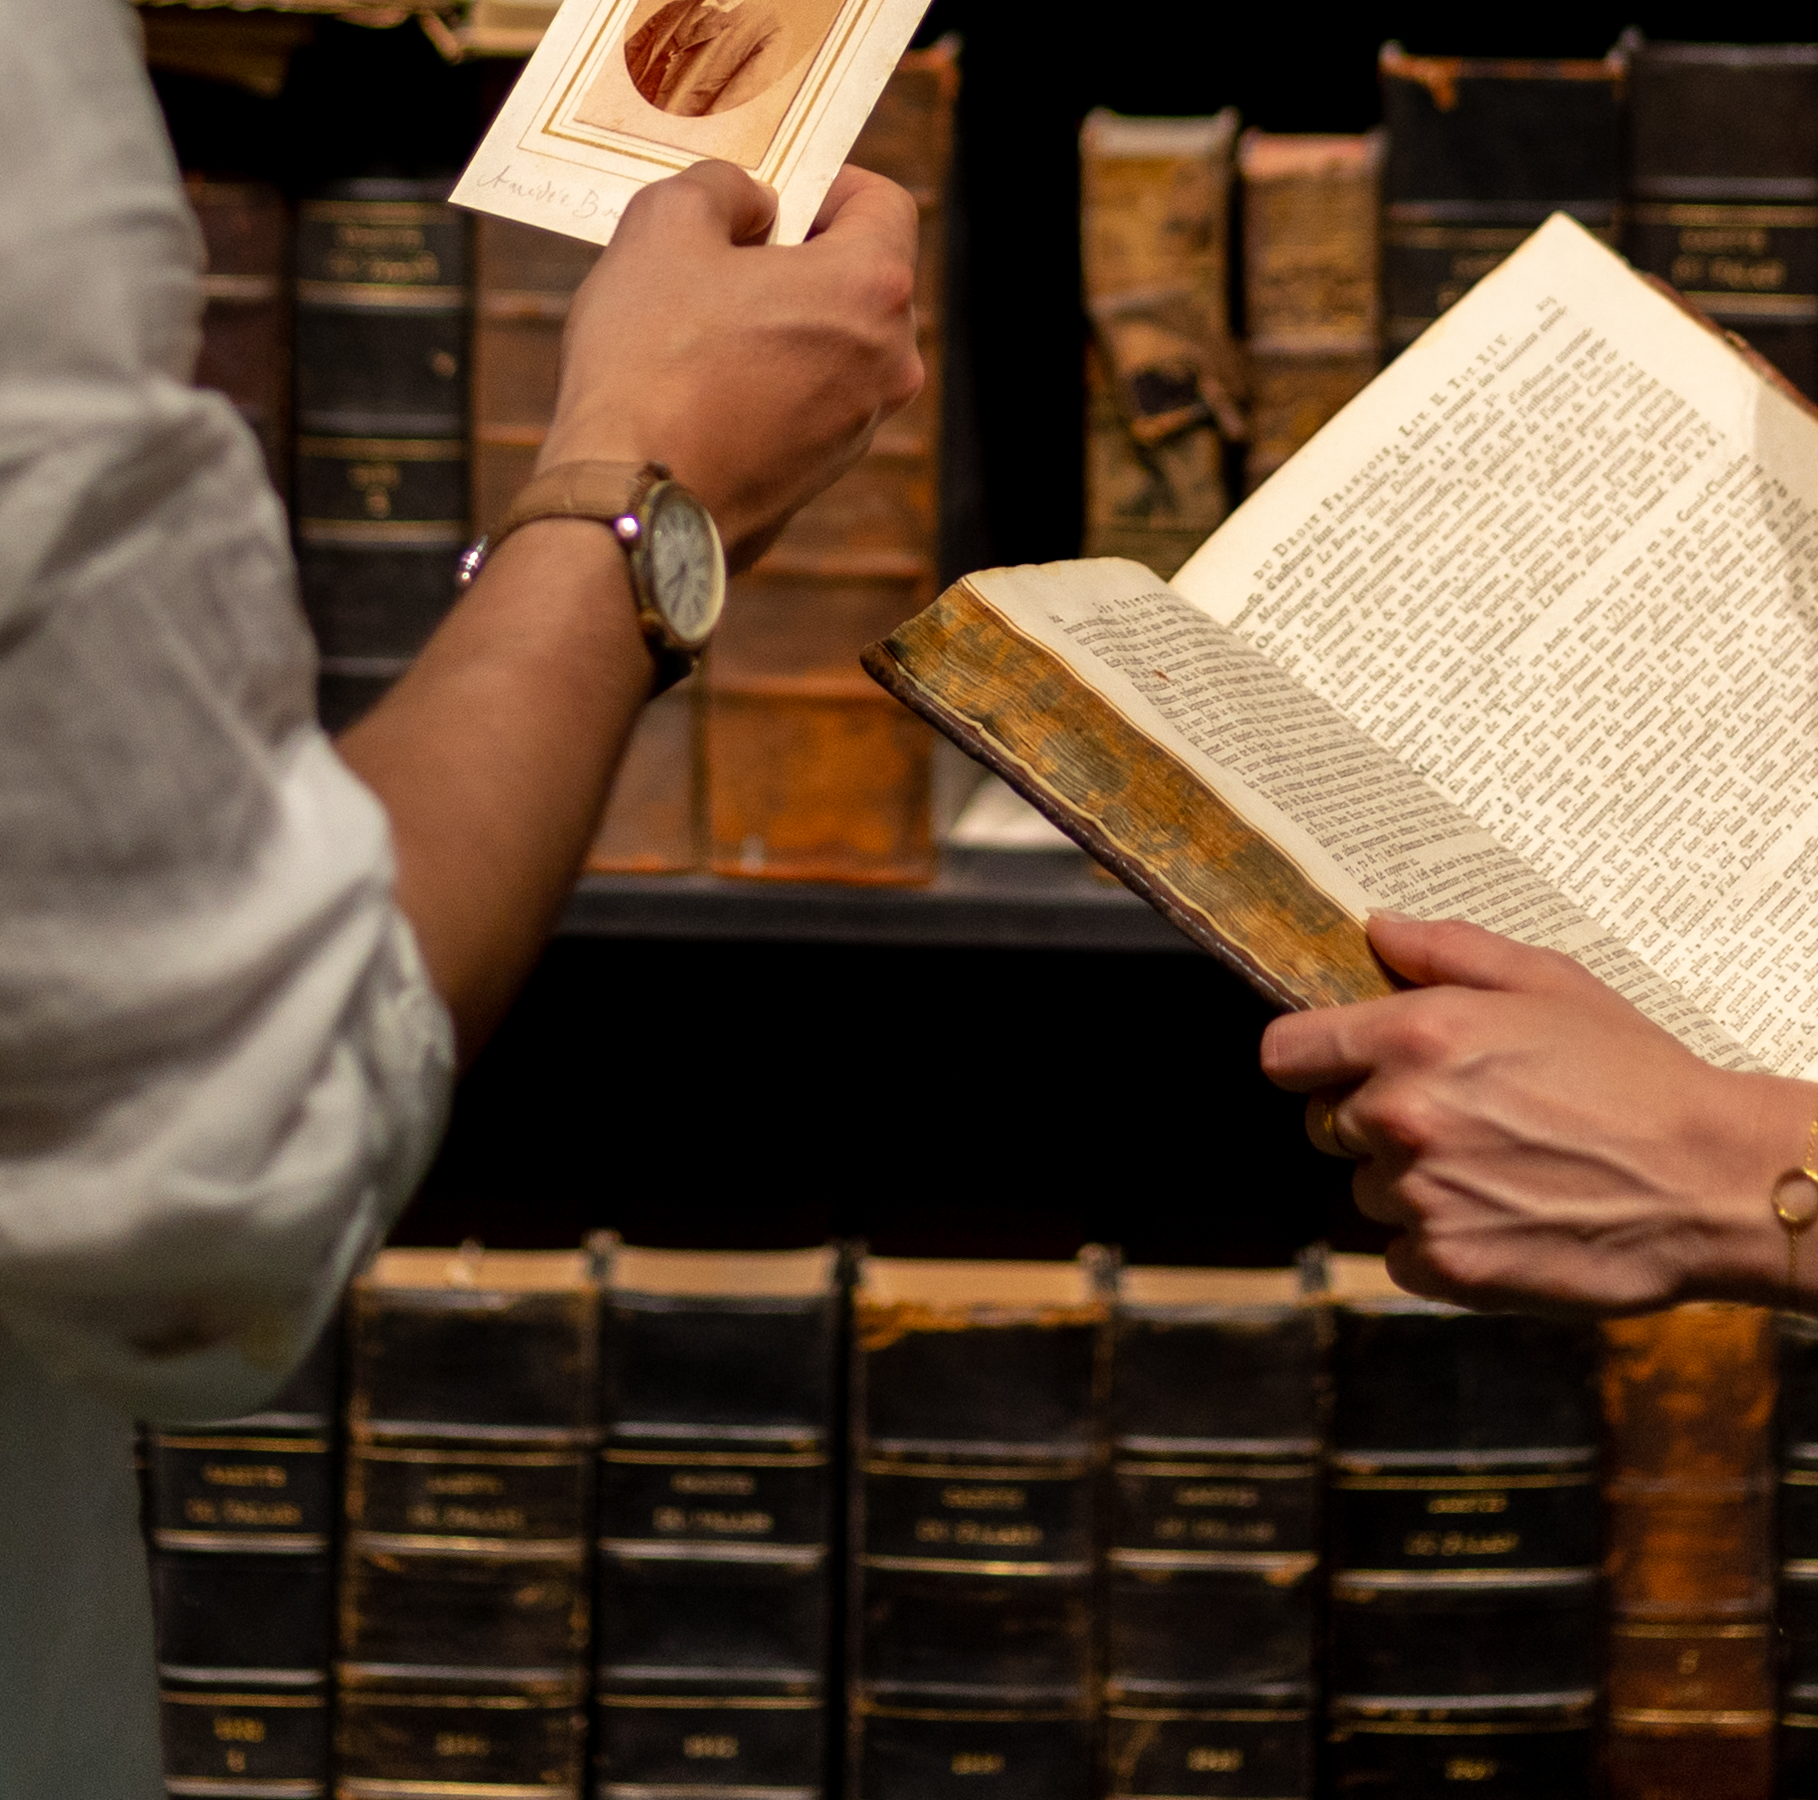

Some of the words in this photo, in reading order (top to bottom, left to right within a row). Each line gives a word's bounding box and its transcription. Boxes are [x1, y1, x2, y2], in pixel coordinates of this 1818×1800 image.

[1440, 387, 1478, 422] comme
[1473, 370, 1496, 389] des
[1491, 331, 1540, 374] donations
[1270, 512, 1322, 558] DROIT
[1297, 608, 1323, 629] des
[1317, 563, 1369, 610] donations
[1462, 456, 1480, 473] en
[1496, 419, 1519, 442] que
[1584, 338, 1606, 361] pro-
[1333, 667, 1359, 690] fait
[1355, 651, 1378, 672] une
[1372, 627, 1403, 652] telle
[1470, 538, 1491, 561] qui
[1498, 498, 1534, 534] promis
